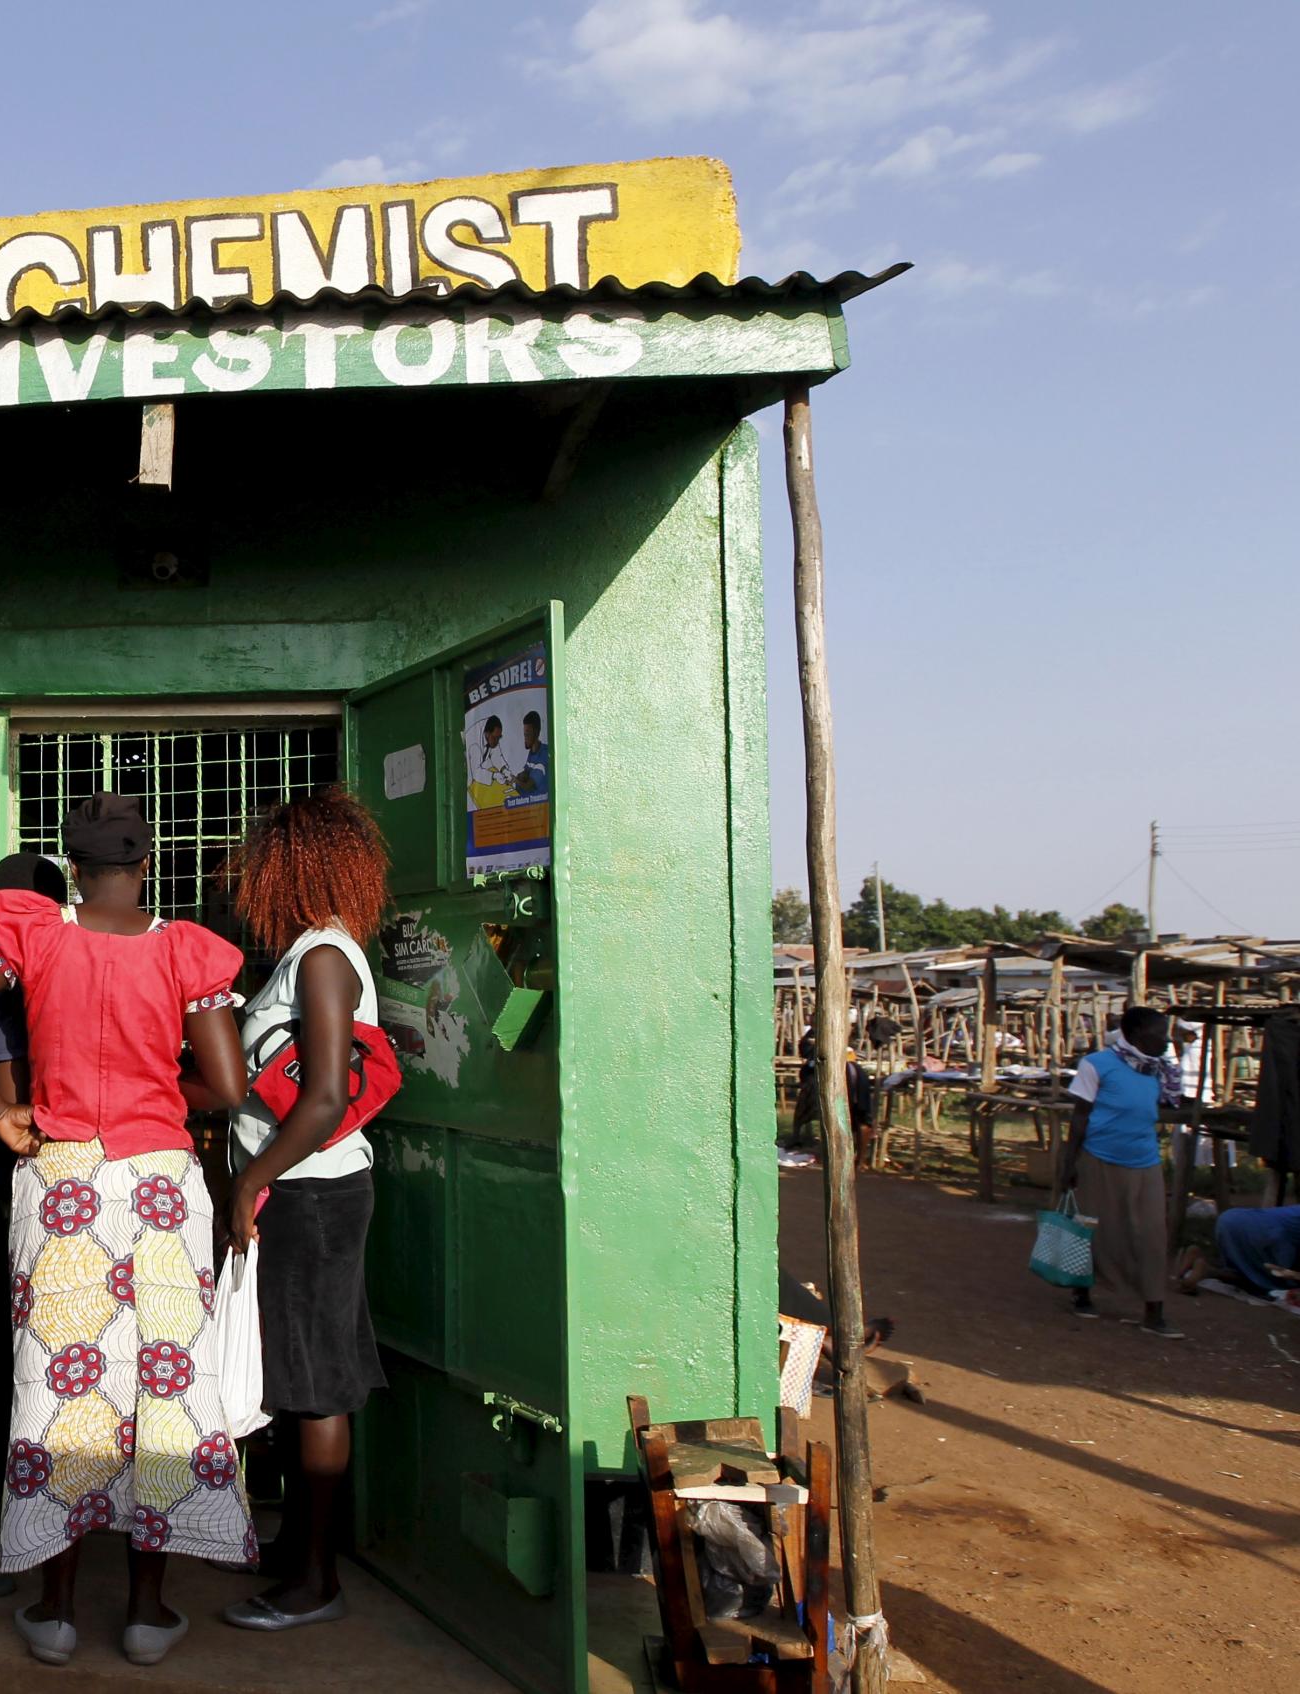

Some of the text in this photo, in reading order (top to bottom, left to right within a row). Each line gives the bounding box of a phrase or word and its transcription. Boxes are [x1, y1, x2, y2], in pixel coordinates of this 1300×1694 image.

[468, 659, 532, 704] BE SURE!
[394, 942, 409, 957] SIM
